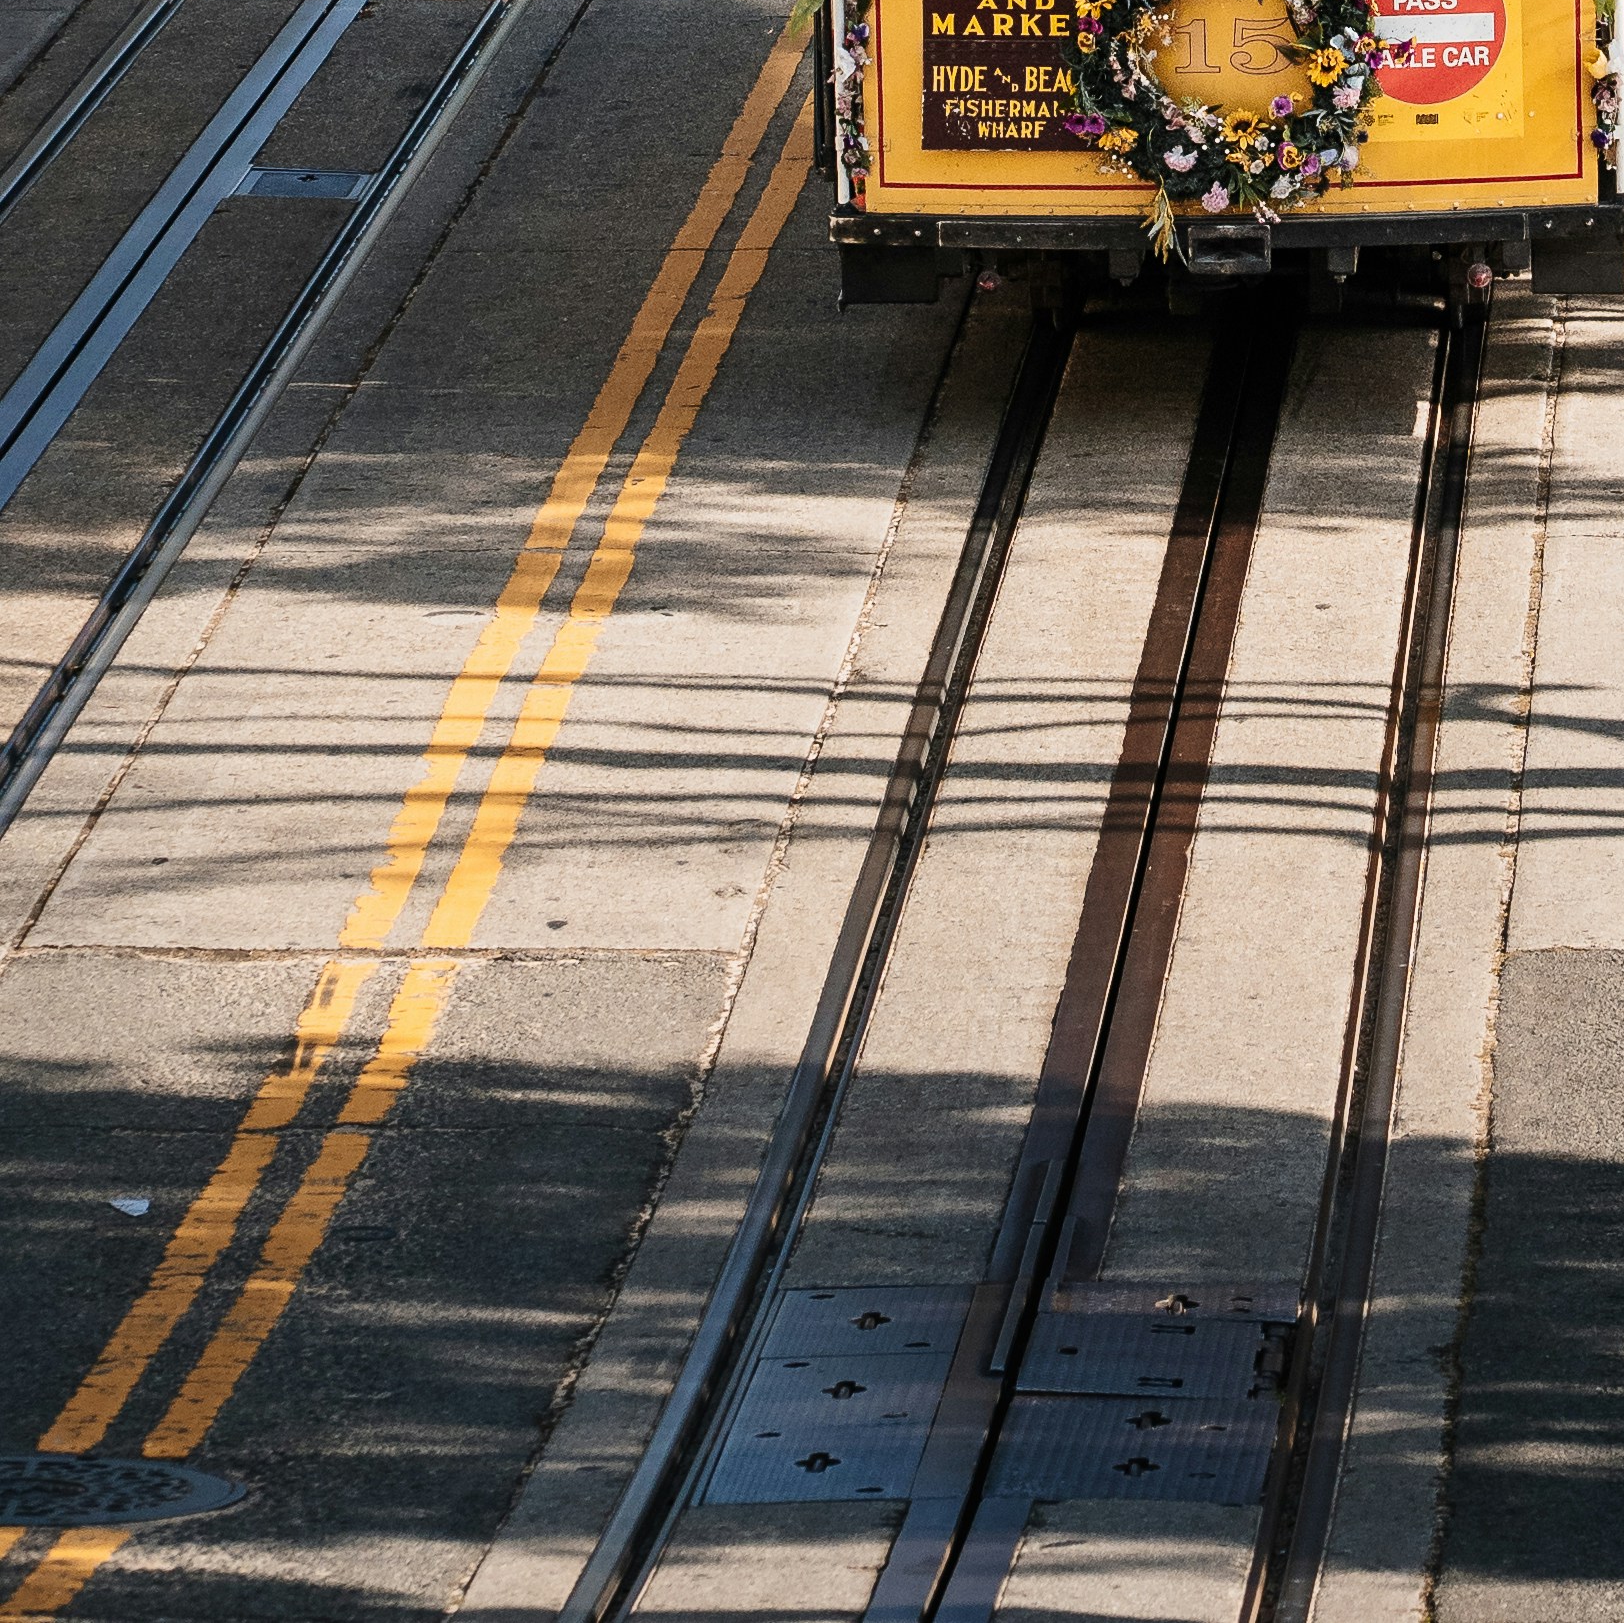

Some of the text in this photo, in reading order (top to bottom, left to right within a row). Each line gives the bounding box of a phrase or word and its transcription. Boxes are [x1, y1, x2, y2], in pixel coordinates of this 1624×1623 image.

[931, 13, 1070, 37] MARKE
[1174, 17, 1295, 75] 15
[1442, 46, 1491, 68] CAR
[932, 66, 988, 92] HYDE
[1024, 66, 1074, 93] BEA
[977, 120, 1047, 139] WHARF
